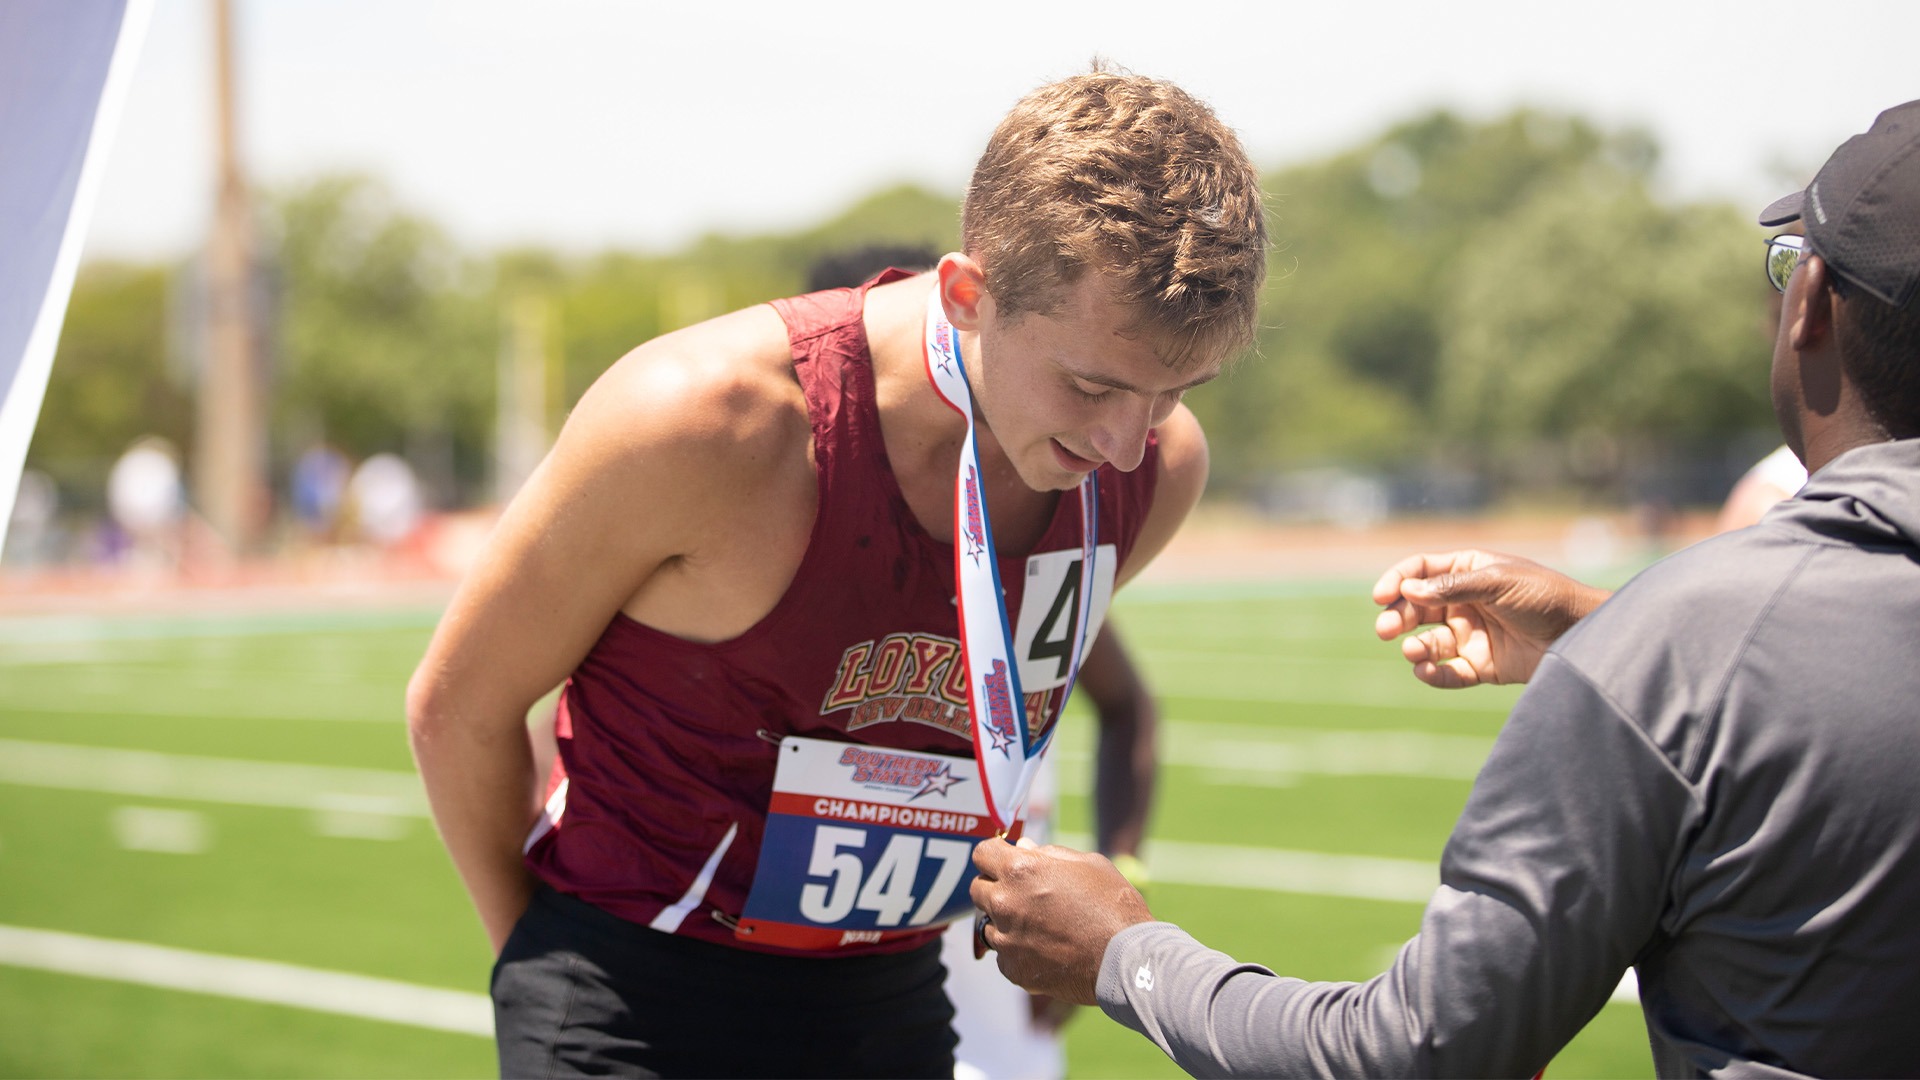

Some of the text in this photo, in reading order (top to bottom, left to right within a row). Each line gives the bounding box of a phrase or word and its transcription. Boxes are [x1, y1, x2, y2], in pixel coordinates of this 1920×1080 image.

[1028, 560, 1083, 680] 4
[849, 696, 906, 731] NEW
[838, 746, 944, 774] SOUTHERN
[852, 764, 924, 788] STATES
[813, 798, 979, 832] CHAMPIONSHIP
[799, 825, 972, 927] 547
